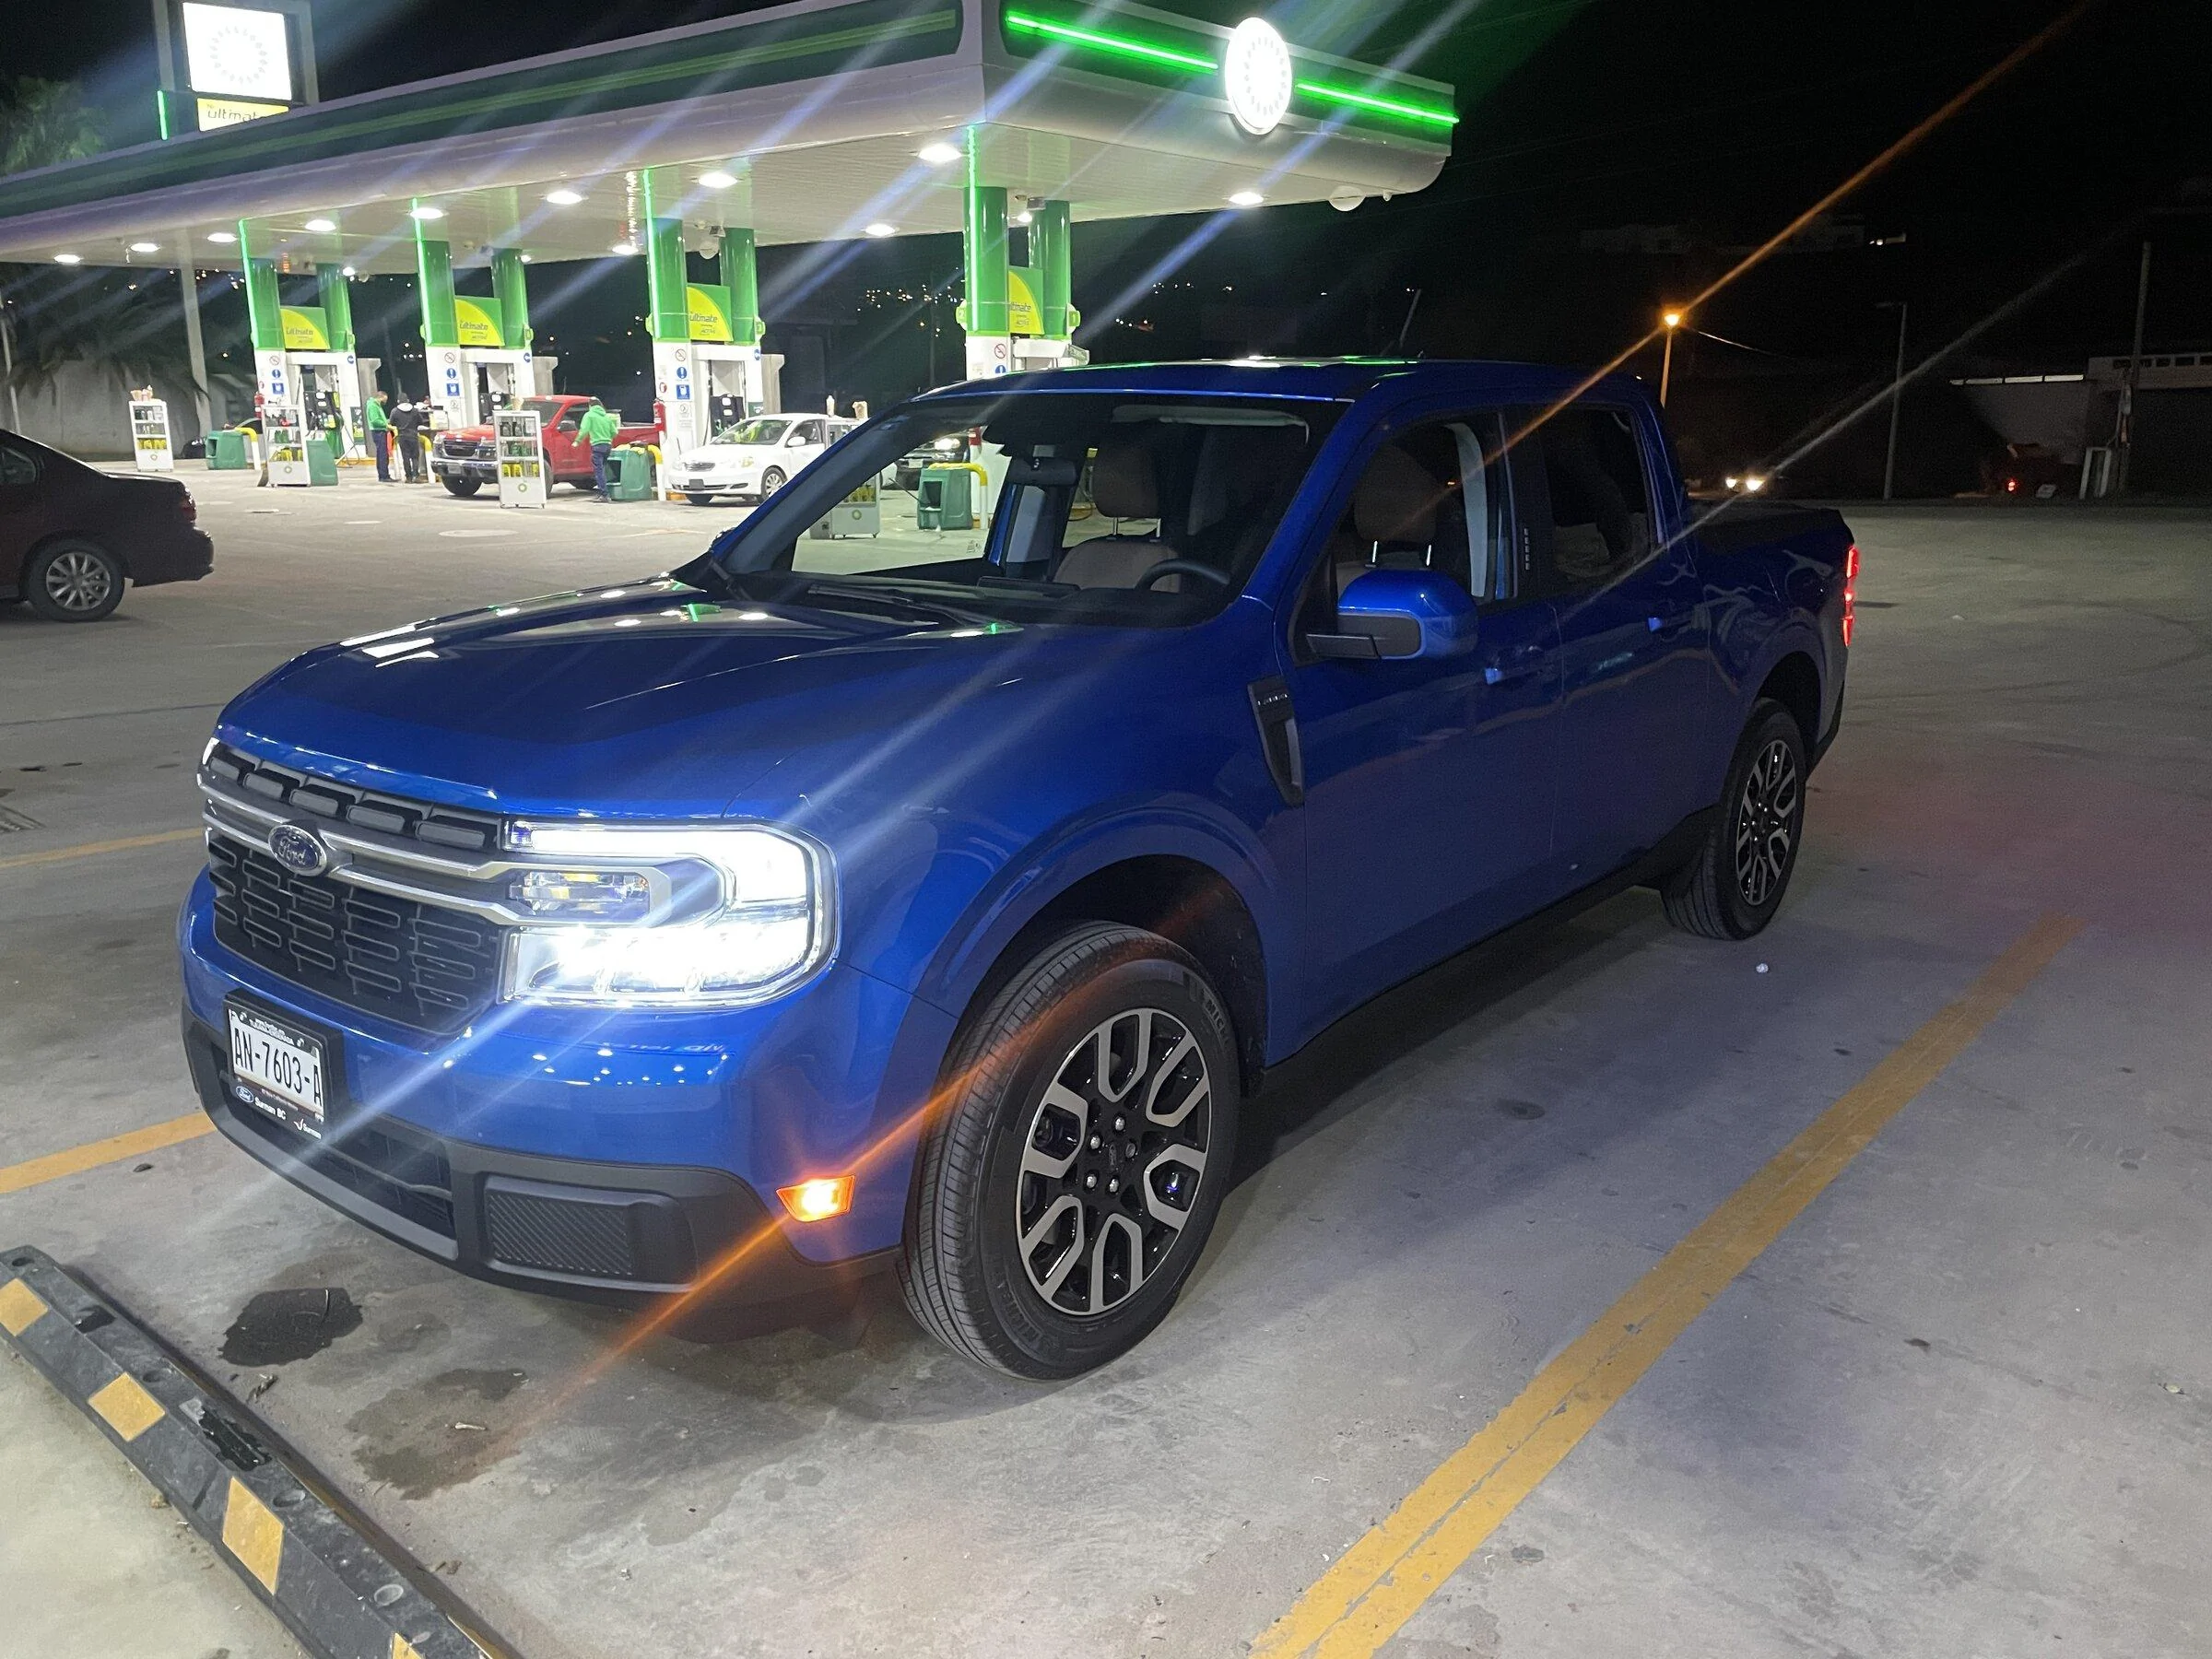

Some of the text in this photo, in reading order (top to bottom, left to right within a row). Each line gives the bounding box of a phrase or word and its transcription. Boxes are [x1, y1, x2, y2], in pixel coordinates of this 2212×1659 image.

[207, 107, 258, 122] ultimat
[277, 835, 307, 865] Ford
[235, 1028, 323, 1107] AN-7603-A
